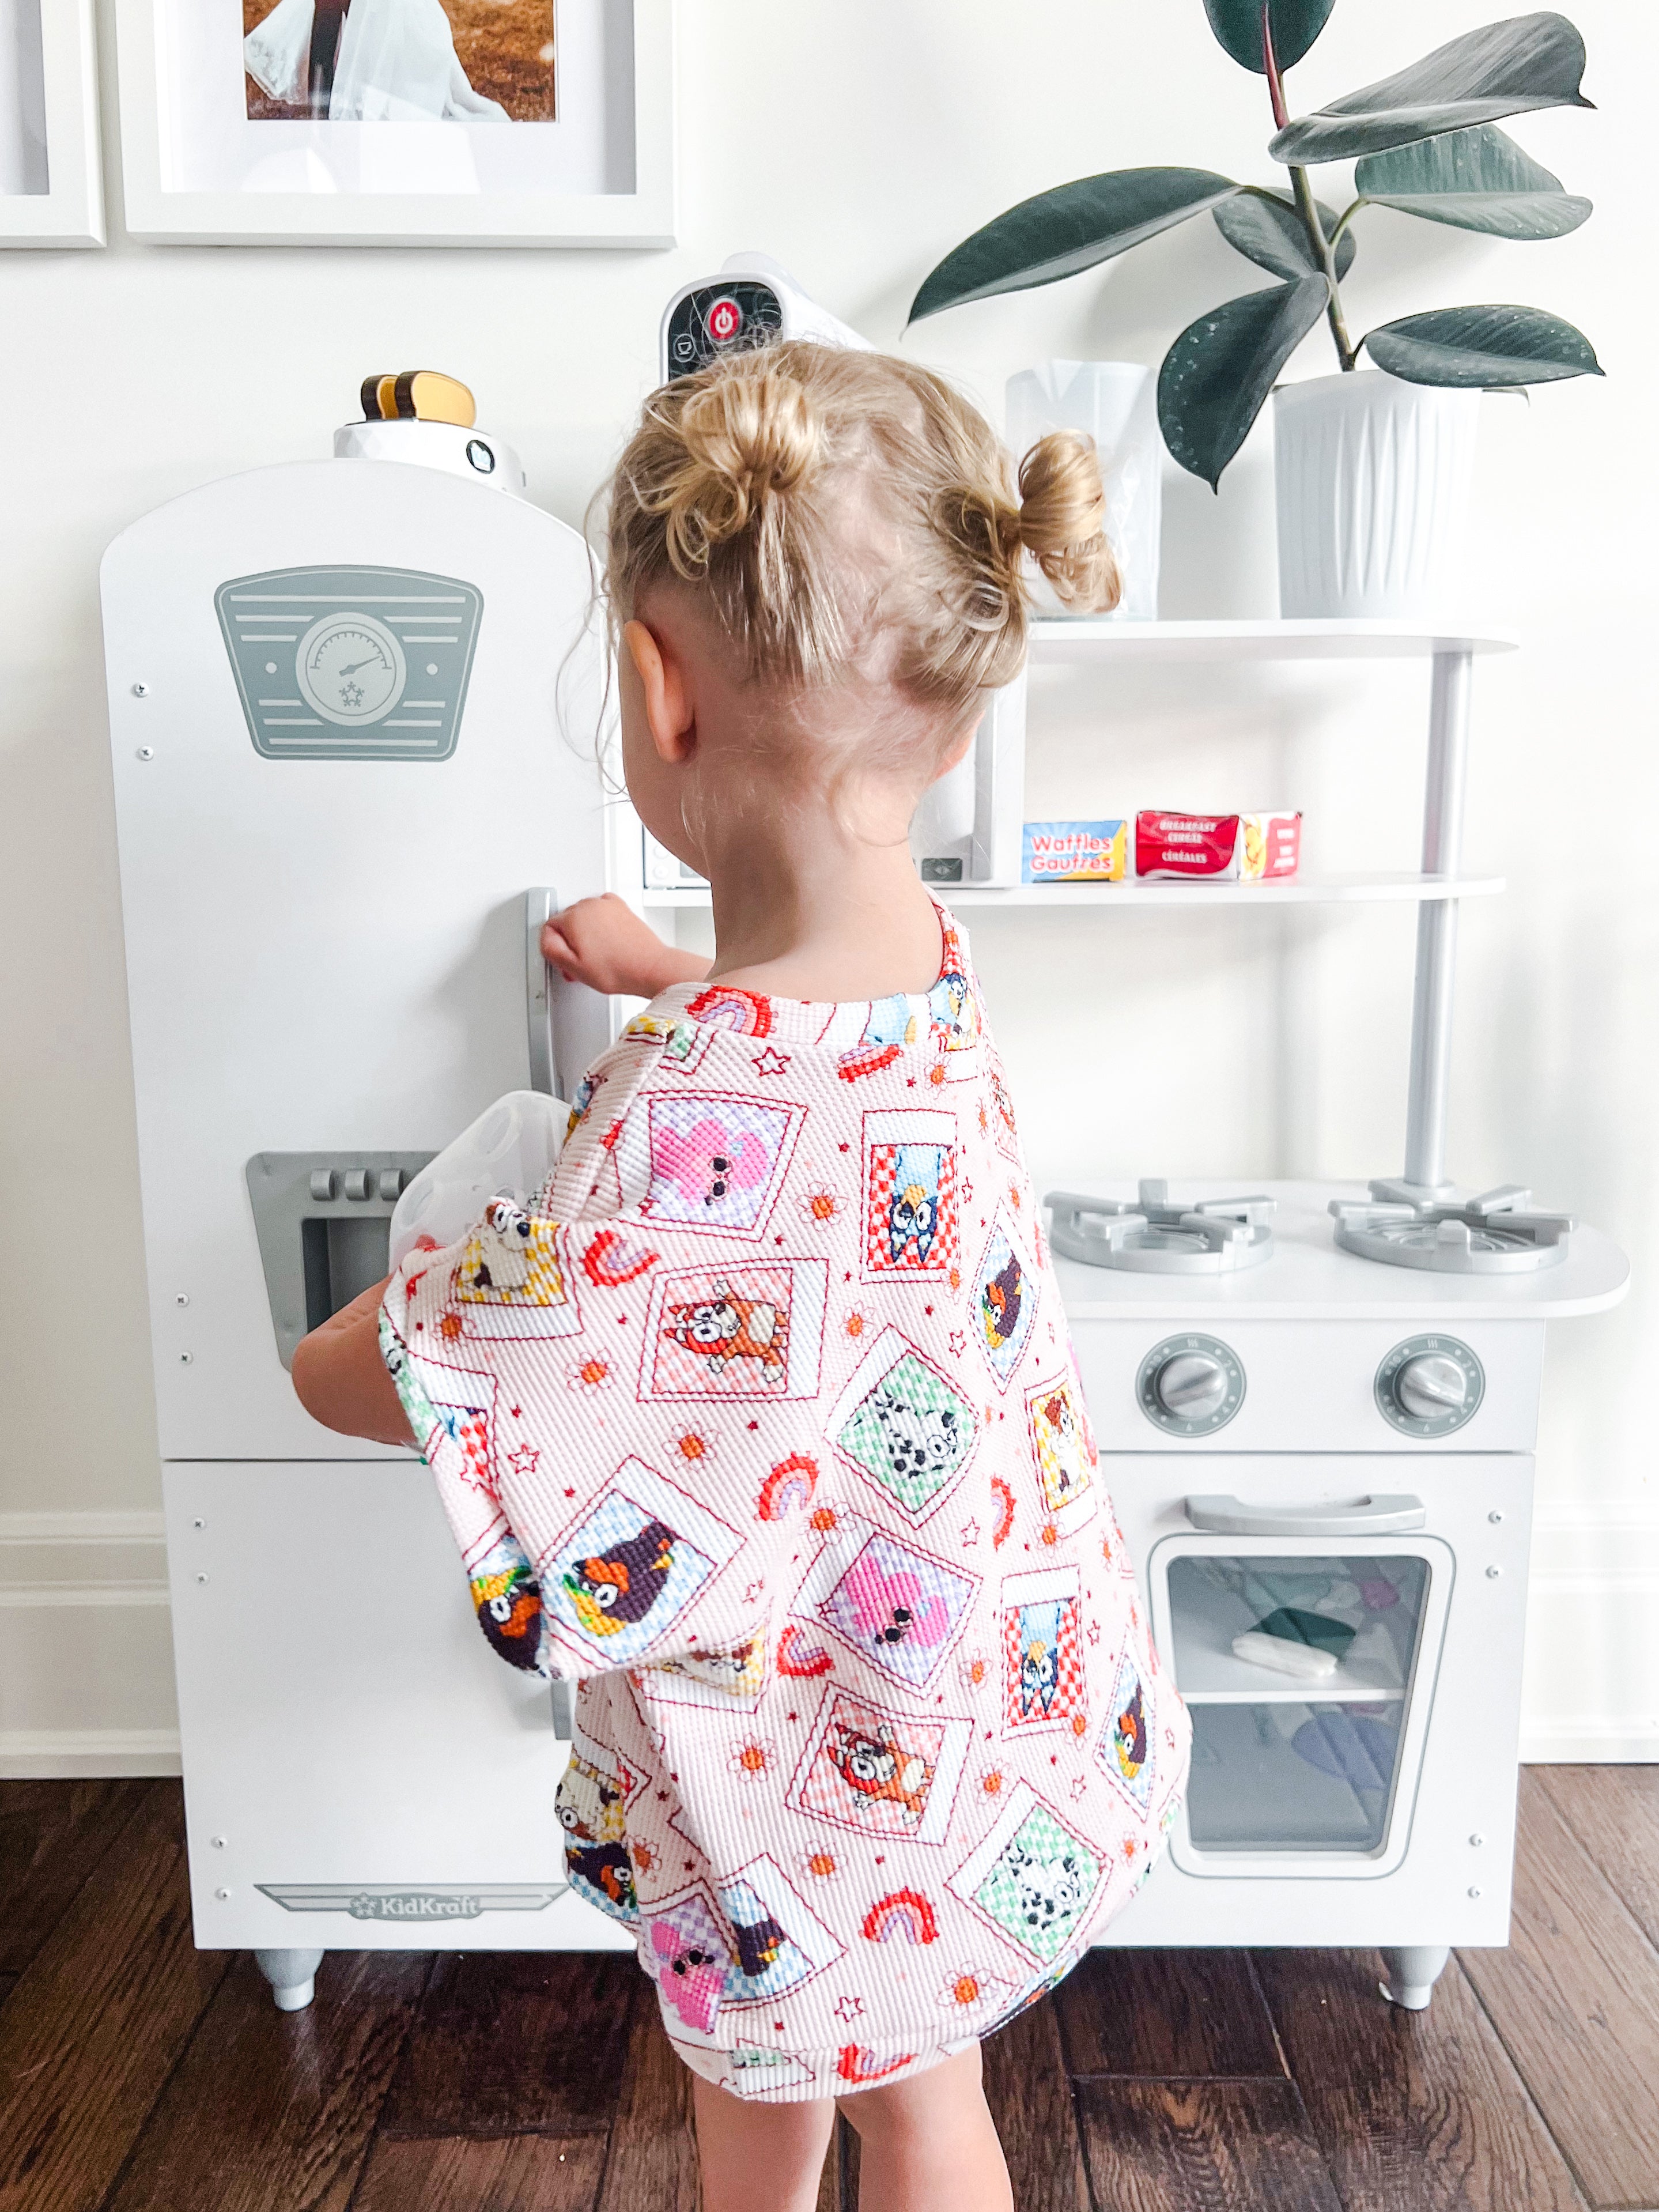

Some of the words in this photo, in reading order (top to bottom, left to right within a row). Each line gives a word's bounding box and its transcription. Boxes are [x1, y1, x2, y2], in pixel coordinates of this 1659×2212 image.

[1031, 833, 1112, 852] Waffles
[1030, 853, 1112, 871] Gaufres
[381, 1896, 479, 1915] KidKraft
